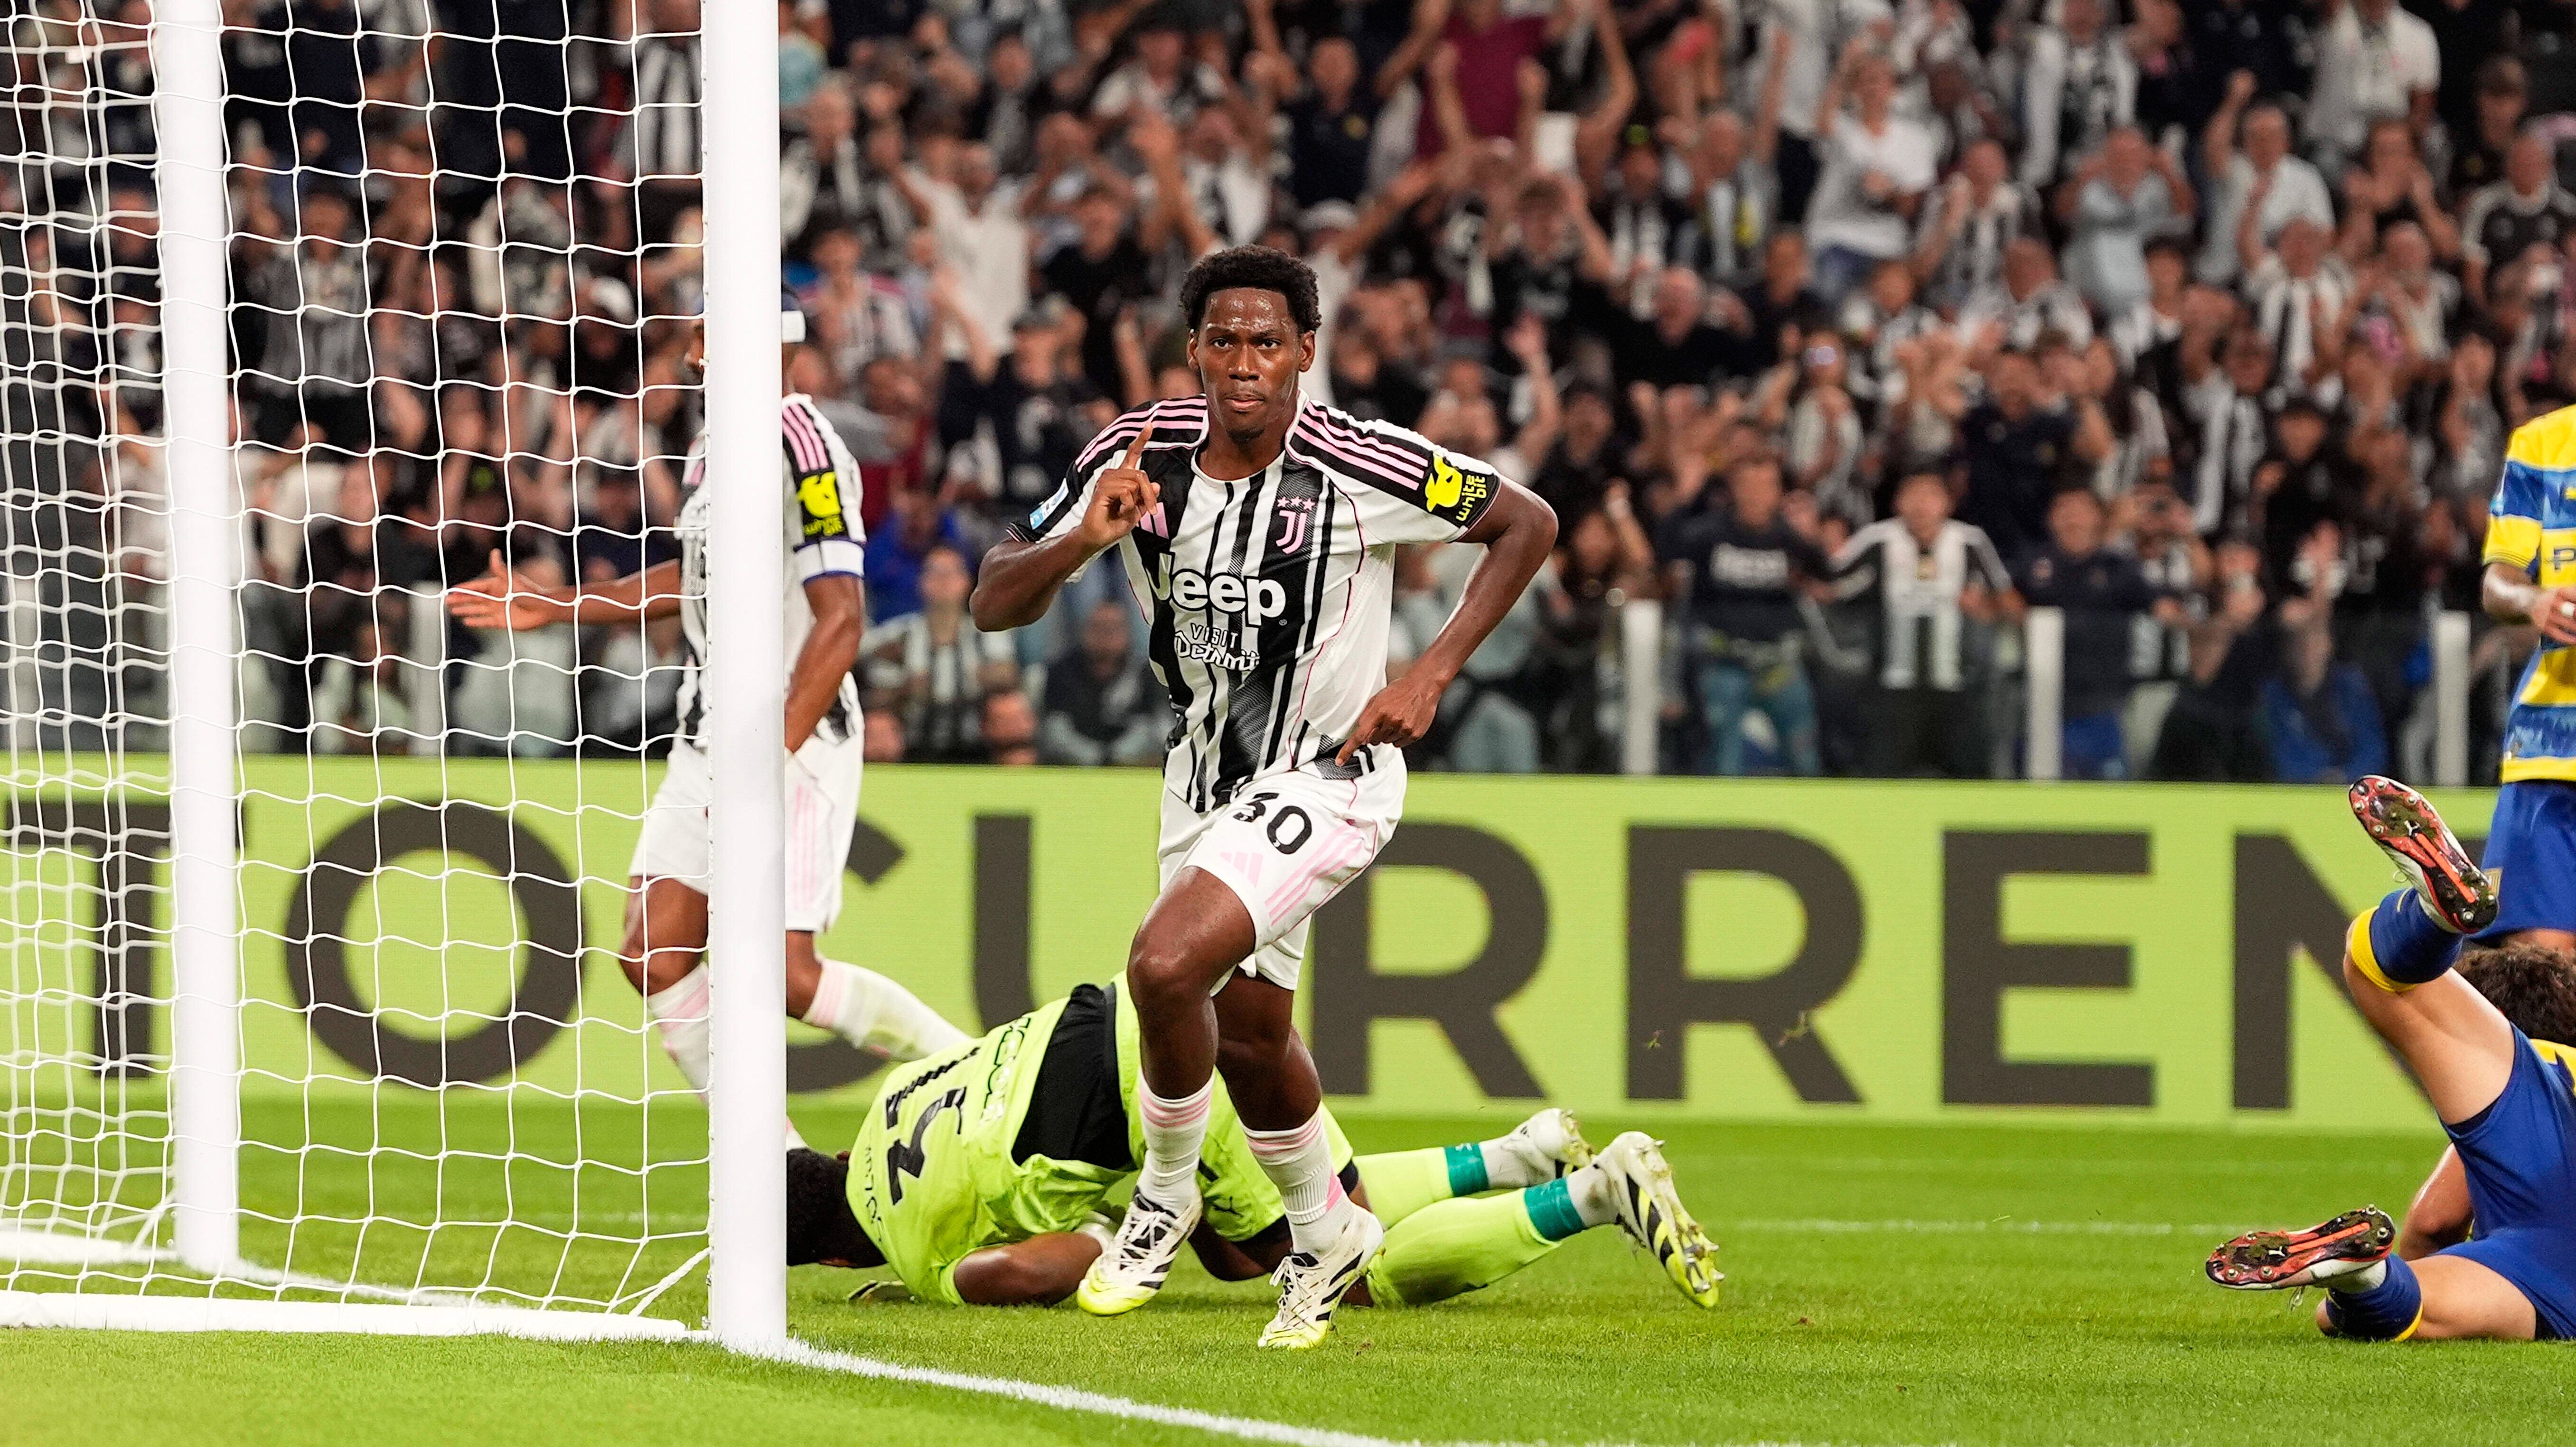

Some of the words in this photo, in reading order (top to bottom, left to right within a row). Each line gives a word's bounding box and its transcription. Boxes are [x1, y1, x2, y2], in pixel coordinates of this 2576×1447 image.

[1456, 475, 1476, 521] white
[1473, 476, 1487, 499] bit
[1145, 552, 1287, 626] Jeep
[1190, 623, 1239, 649] VISIT
[1233, 792, 1312, 855] 30
